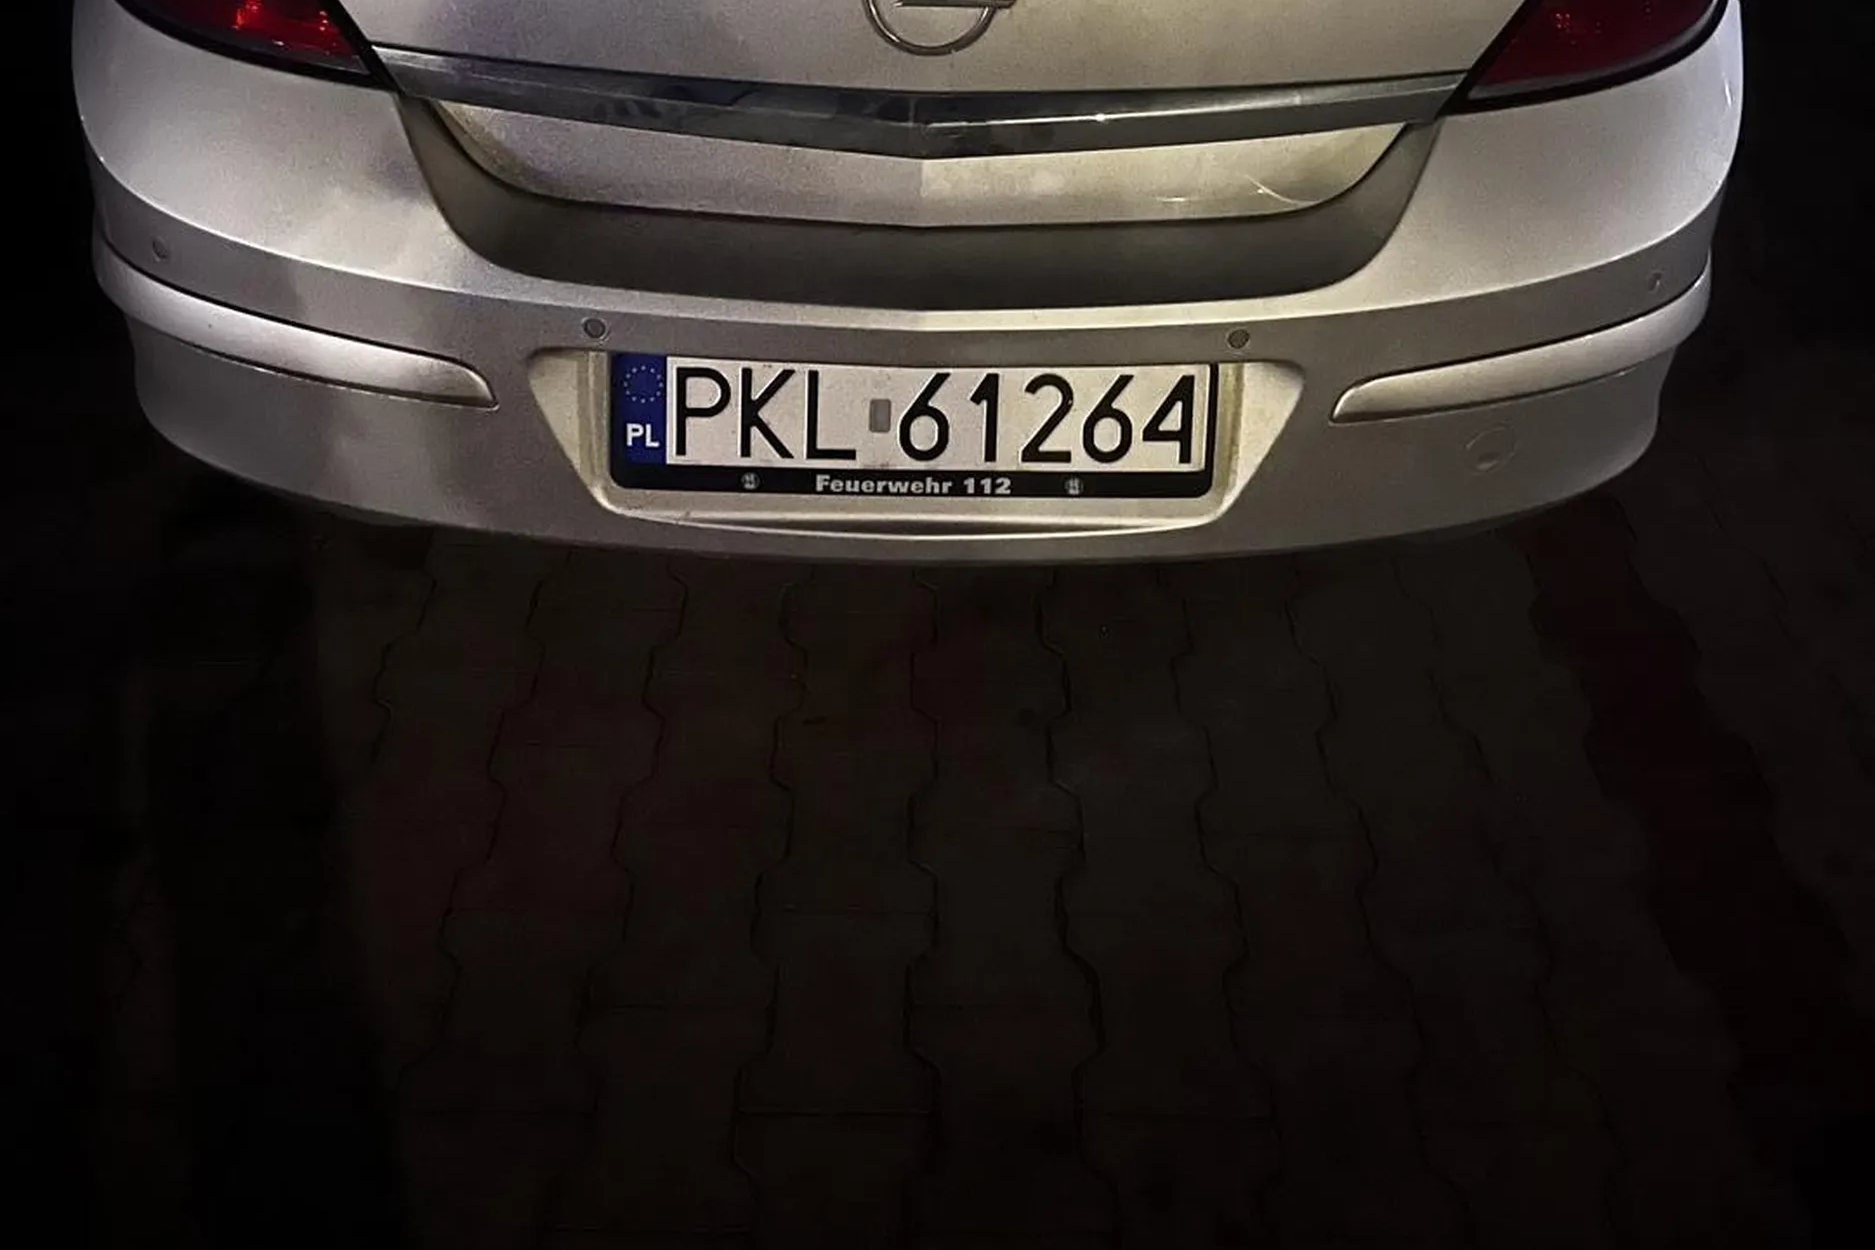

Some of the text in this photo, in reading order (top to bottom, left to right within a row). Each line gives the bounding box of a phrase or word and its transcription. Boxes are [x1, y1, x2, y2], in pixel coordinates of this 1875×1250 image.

[675, 366, 1196, 464] PKL 61264
[625, 422, 661, 448] PL
[815, 474, 1012, 495] Feuerwehr 112
